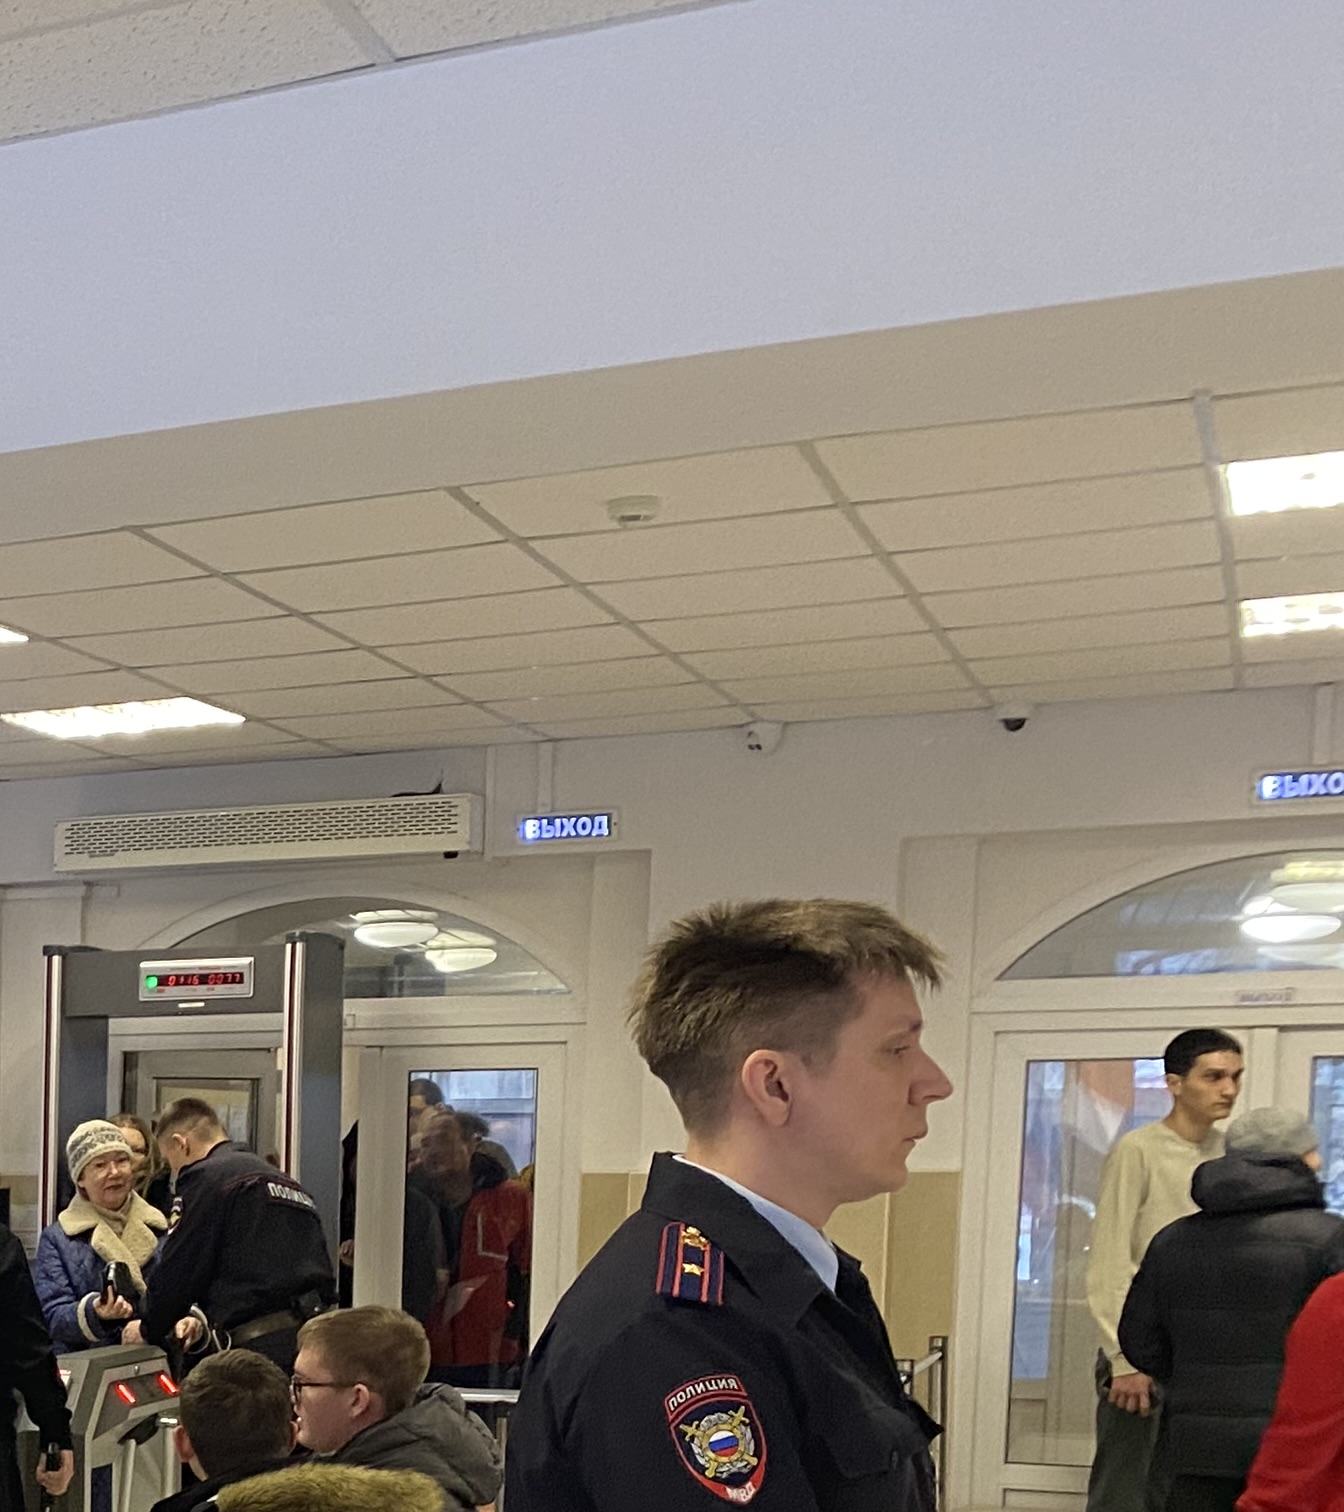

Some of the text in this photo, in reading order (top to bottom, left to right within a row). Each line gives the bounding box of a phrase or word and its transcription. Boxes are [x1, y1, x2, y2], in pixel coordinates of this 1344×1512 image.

[1261, 772, 1344, 800] ВЫХО
[524, 815, 609, 839] ВЫХОД
[668, 1378, 739, 1411] ПОЛИЦИЯ
[725, 1481, 757, 1502] МВД
